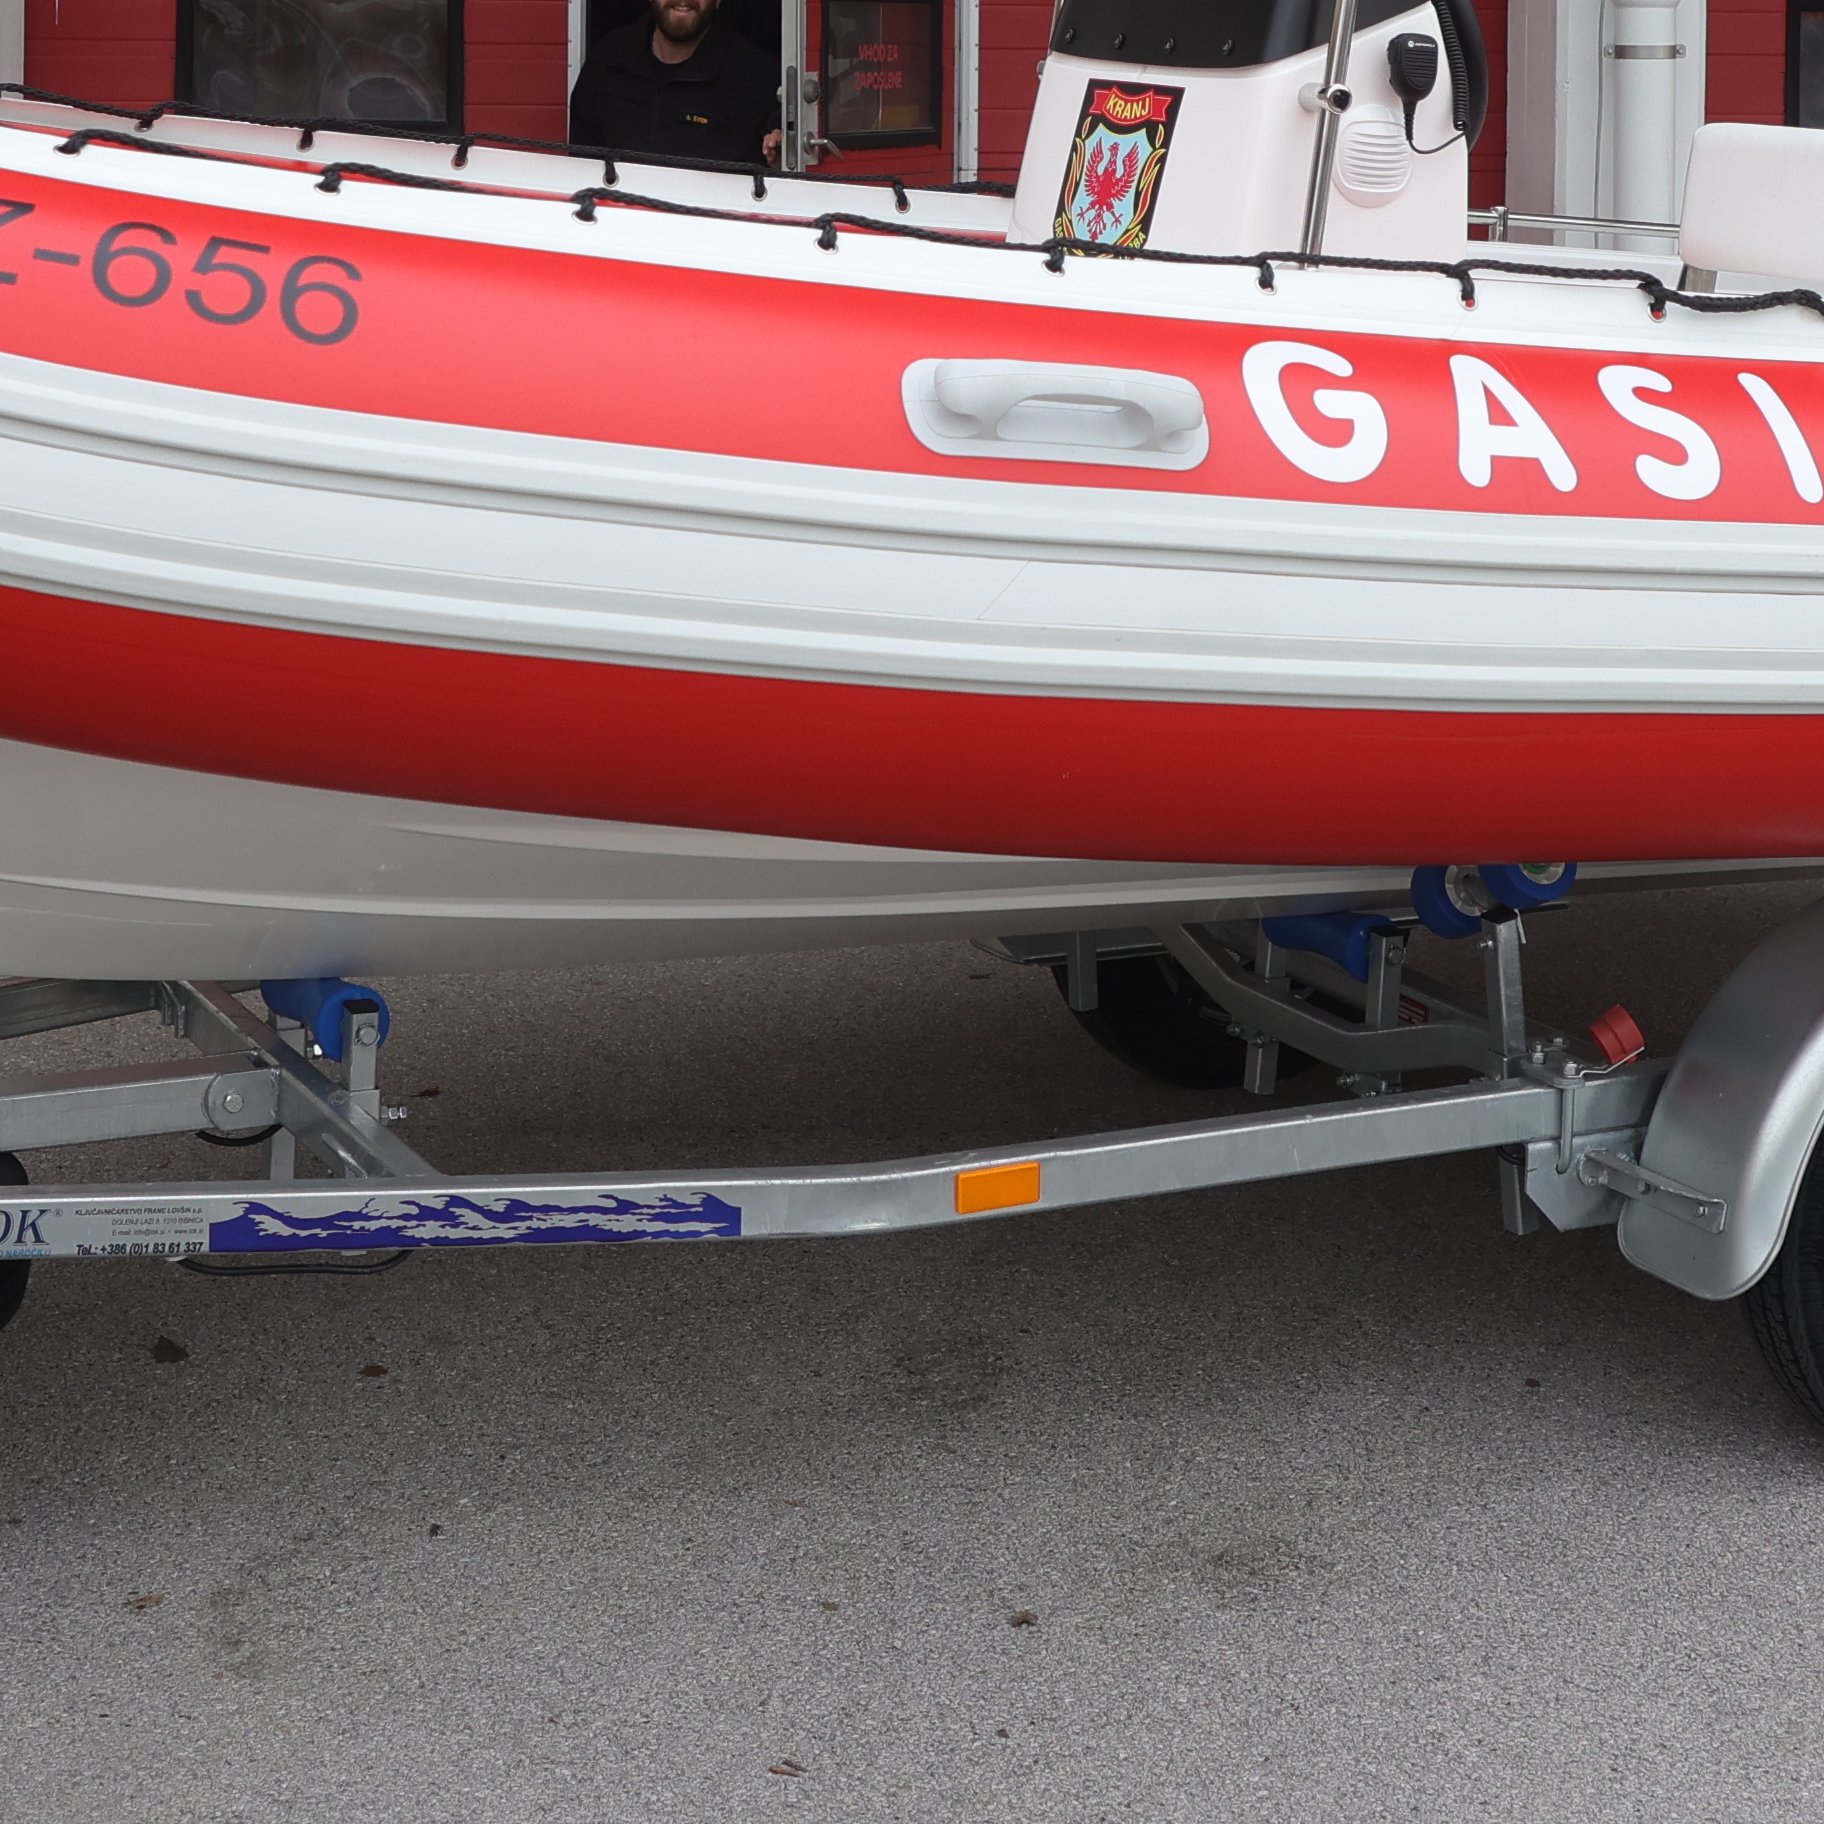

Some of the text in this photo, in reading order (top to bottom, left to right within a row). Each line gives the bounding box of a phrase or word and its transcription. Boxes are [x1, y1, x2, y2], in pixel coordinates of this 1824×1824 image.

[1105, 93, 1150, 119] KRANJ
[76, 1241, 204, 1256] Tel.: +386 (0)1 83 61 337
